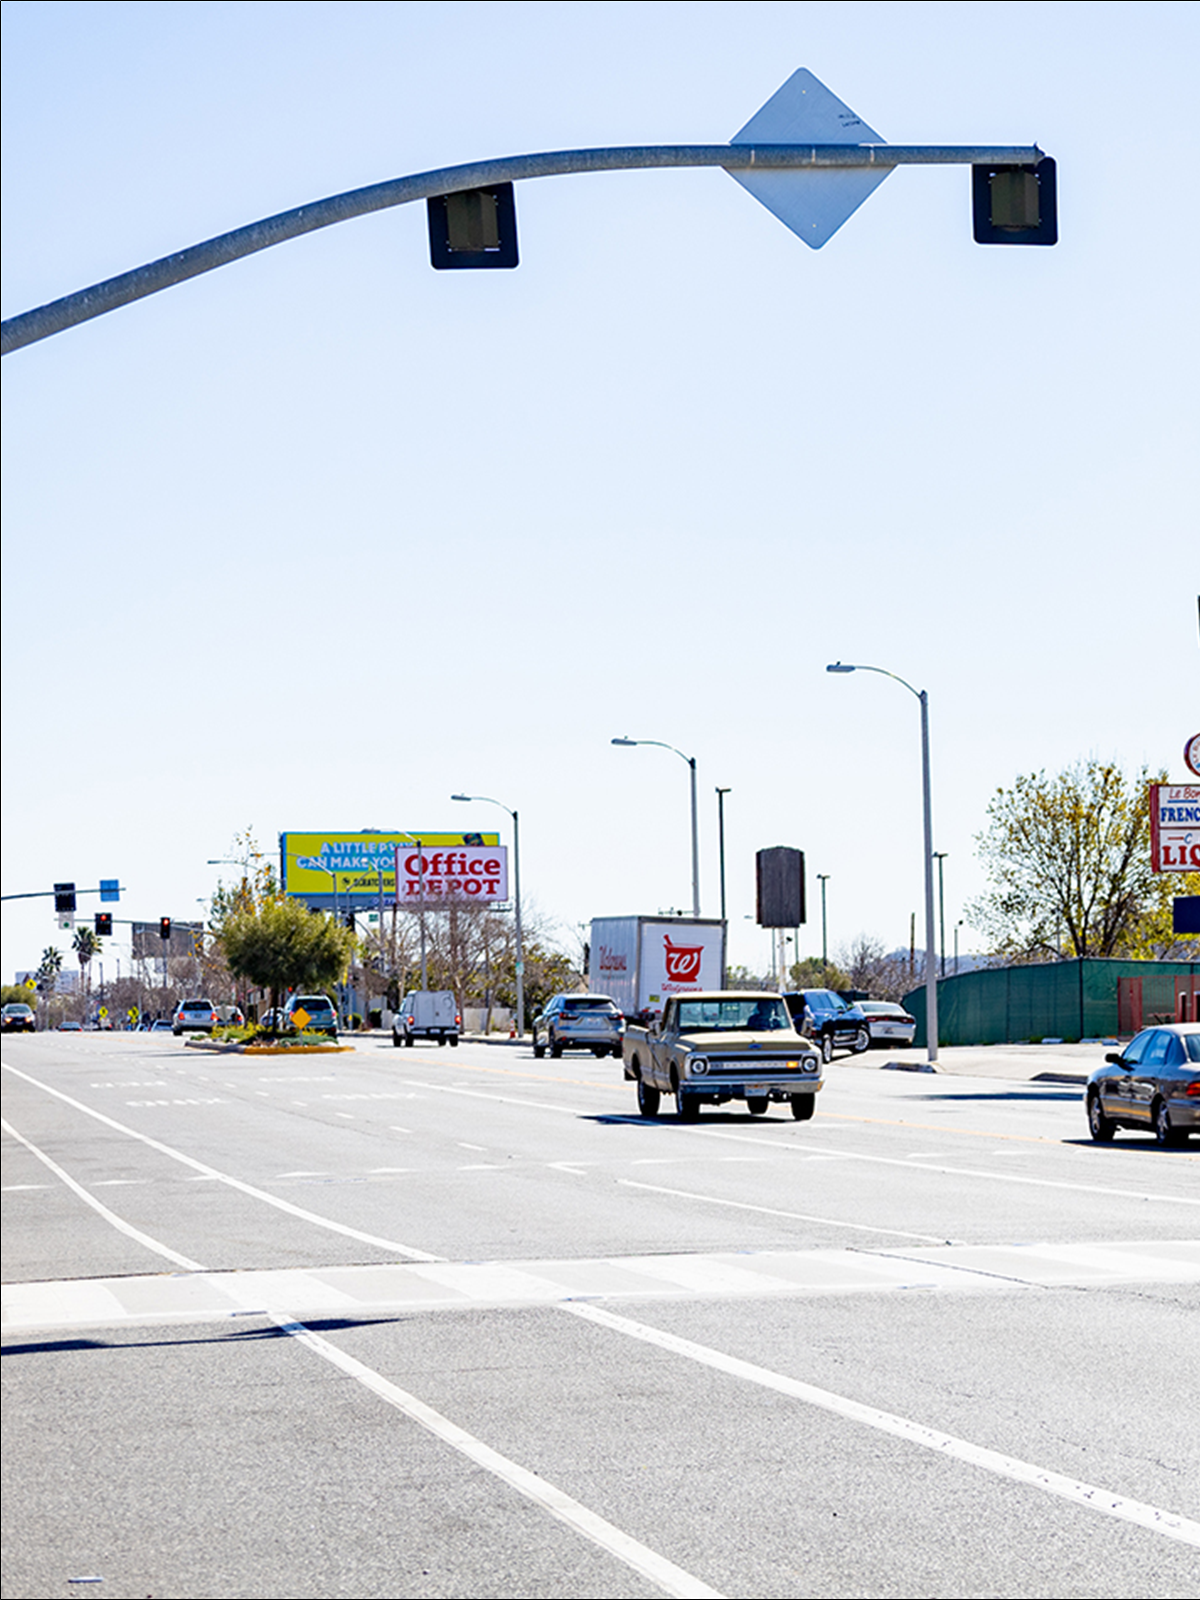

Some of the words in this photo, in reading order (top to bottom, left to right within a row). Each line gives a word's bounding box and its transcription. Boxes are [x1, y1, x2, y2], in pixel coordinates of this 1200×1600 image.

[1169, 788, 1182, 799] Le
[321, 842, 330, 854] A
[333, 842, 376, 854] LITTLE
[296, 856, 328, 869] CAN
[330, 857, 369, 869] MAKE
[404, 853, 500, 876] Office
[405, 880, 500, 897] DEPOT
